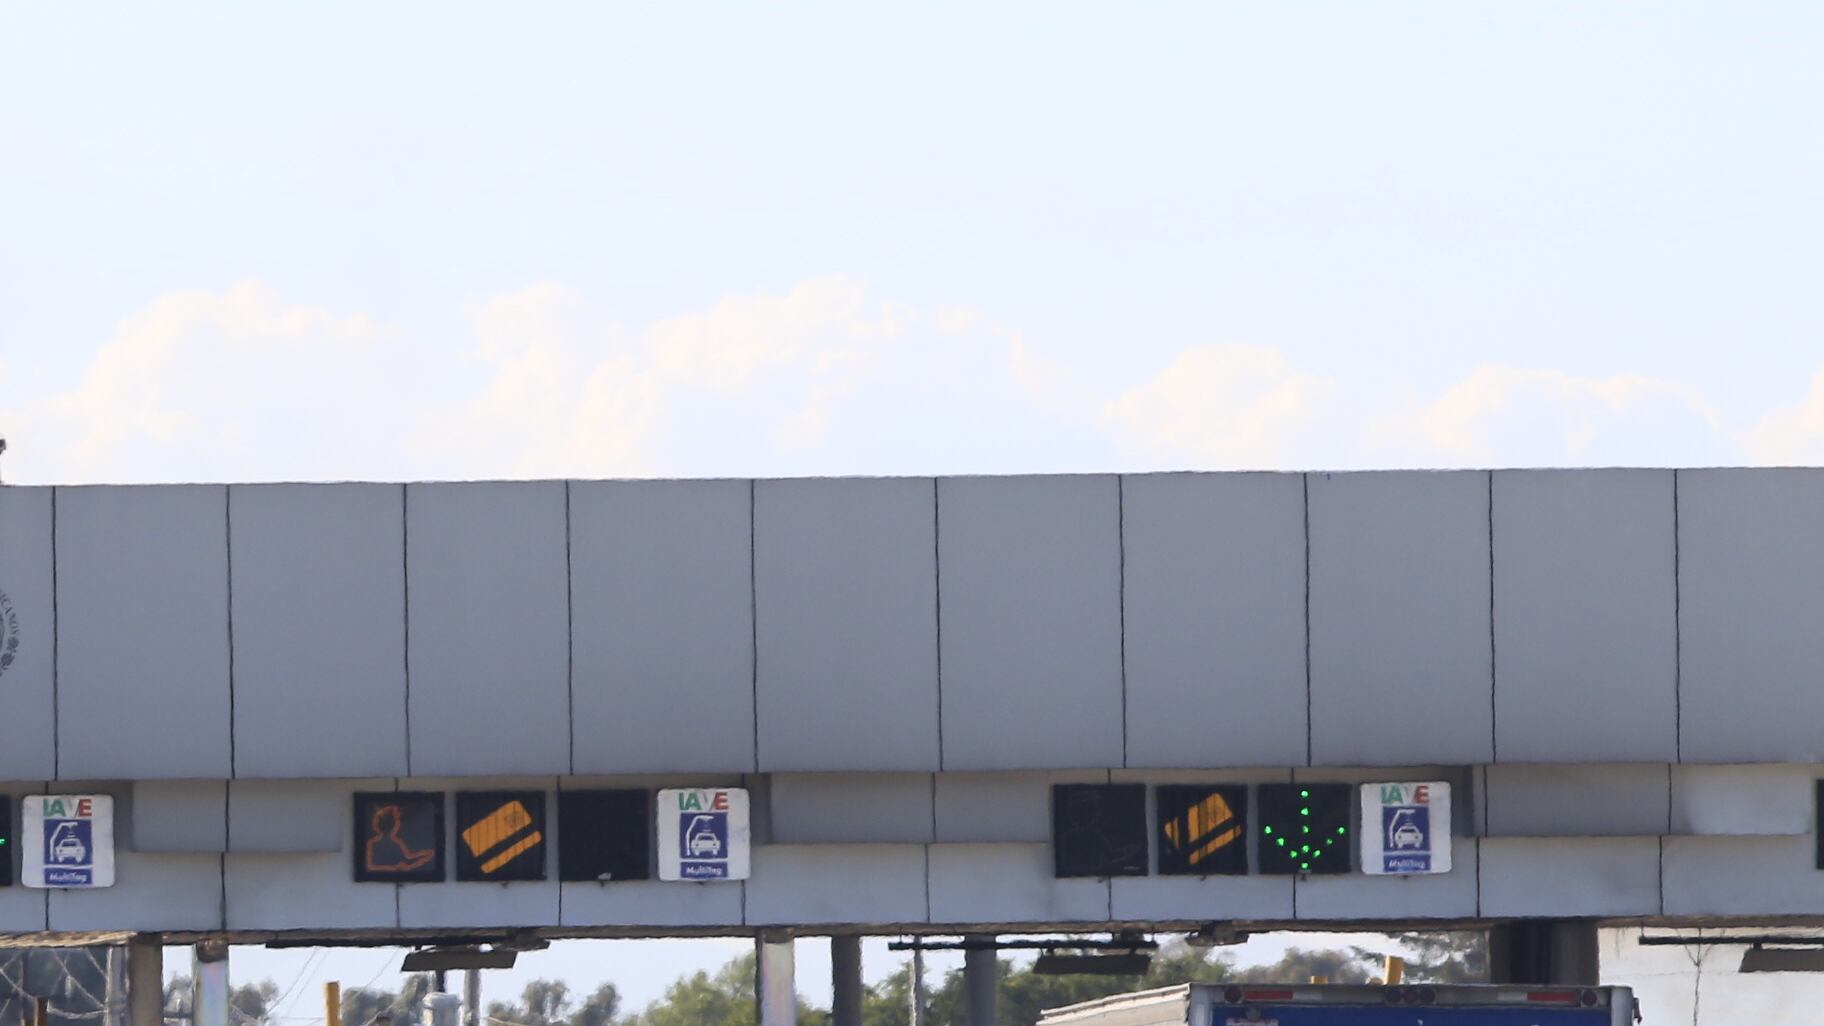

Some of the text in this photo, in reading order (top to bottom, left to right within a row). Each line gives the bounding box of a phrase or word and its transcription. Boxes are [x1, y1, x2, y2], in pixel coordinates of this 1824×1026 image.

[678, 791, 729, 811] IAVE
[1381, 785, 1430, 804] IAVE
[43, 797, 93, 817] IAVE
